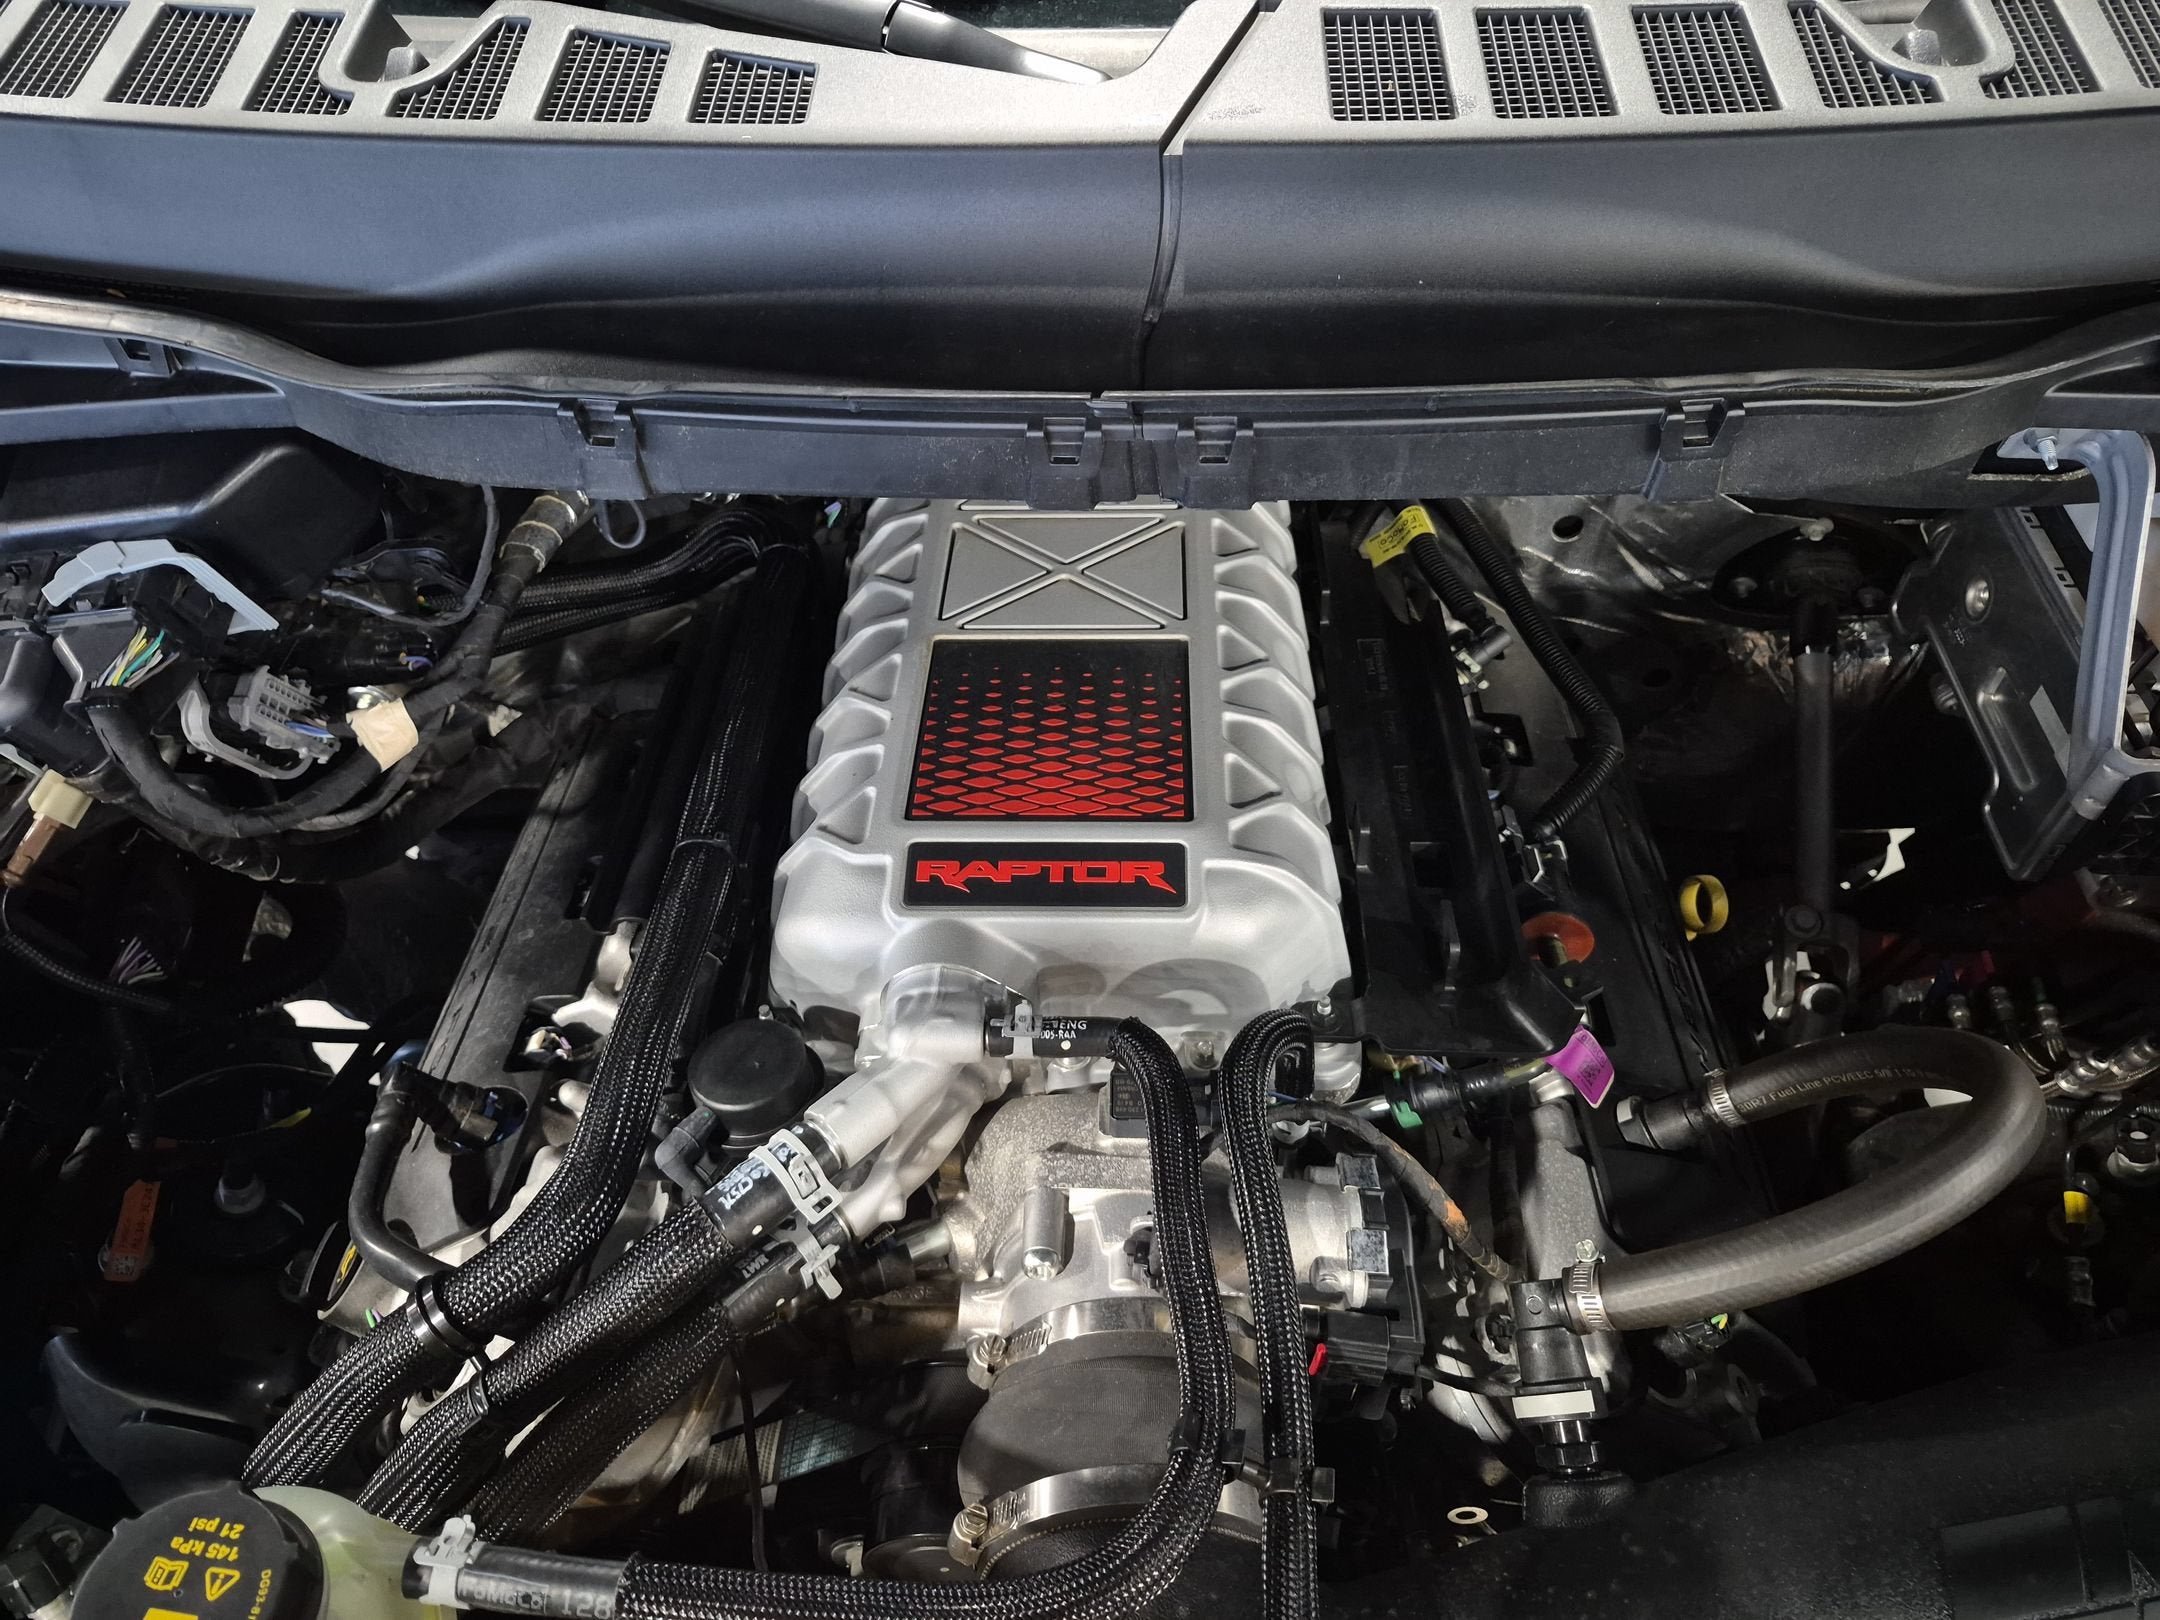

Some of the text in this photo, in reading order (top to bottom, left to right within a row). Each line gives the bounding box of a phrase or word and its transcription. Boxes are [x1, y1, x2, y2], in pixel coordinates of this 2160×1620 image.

[915, 860, 1177, 893] RAPTOR
[1769, 1087, 1797, 1102] Fuel
[1798, 1079, 1822, 1095] Line
[188, 1516, 245, 1540] 21 psi
[170, 1536, 239, 1561] 145 kPa
